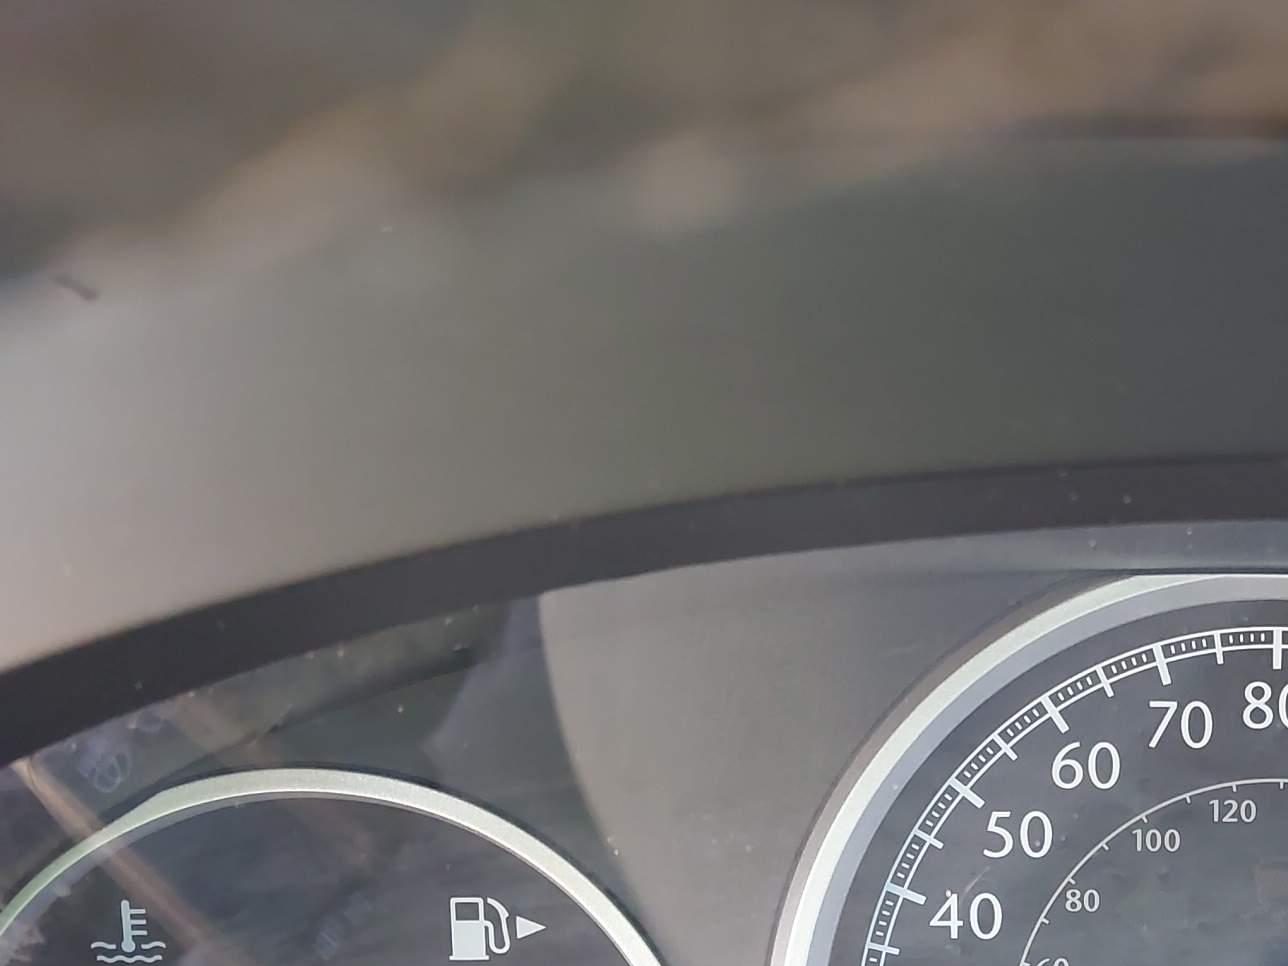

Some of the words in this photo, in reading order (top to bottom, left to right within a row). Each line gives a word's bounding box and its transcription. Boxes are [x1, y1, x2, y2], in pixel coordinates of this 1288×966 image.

[1148, 700, 1213, 749] 70
[1051, 741, 1121, 790] 60
[983, 810, 1053, 858] 50
[1208, 799, 1257, 823] 120
[1132, 828, 1181, 852] 100
[929, 889, 1003, 940] 40
[1065, 888, 1100, 912] 80
